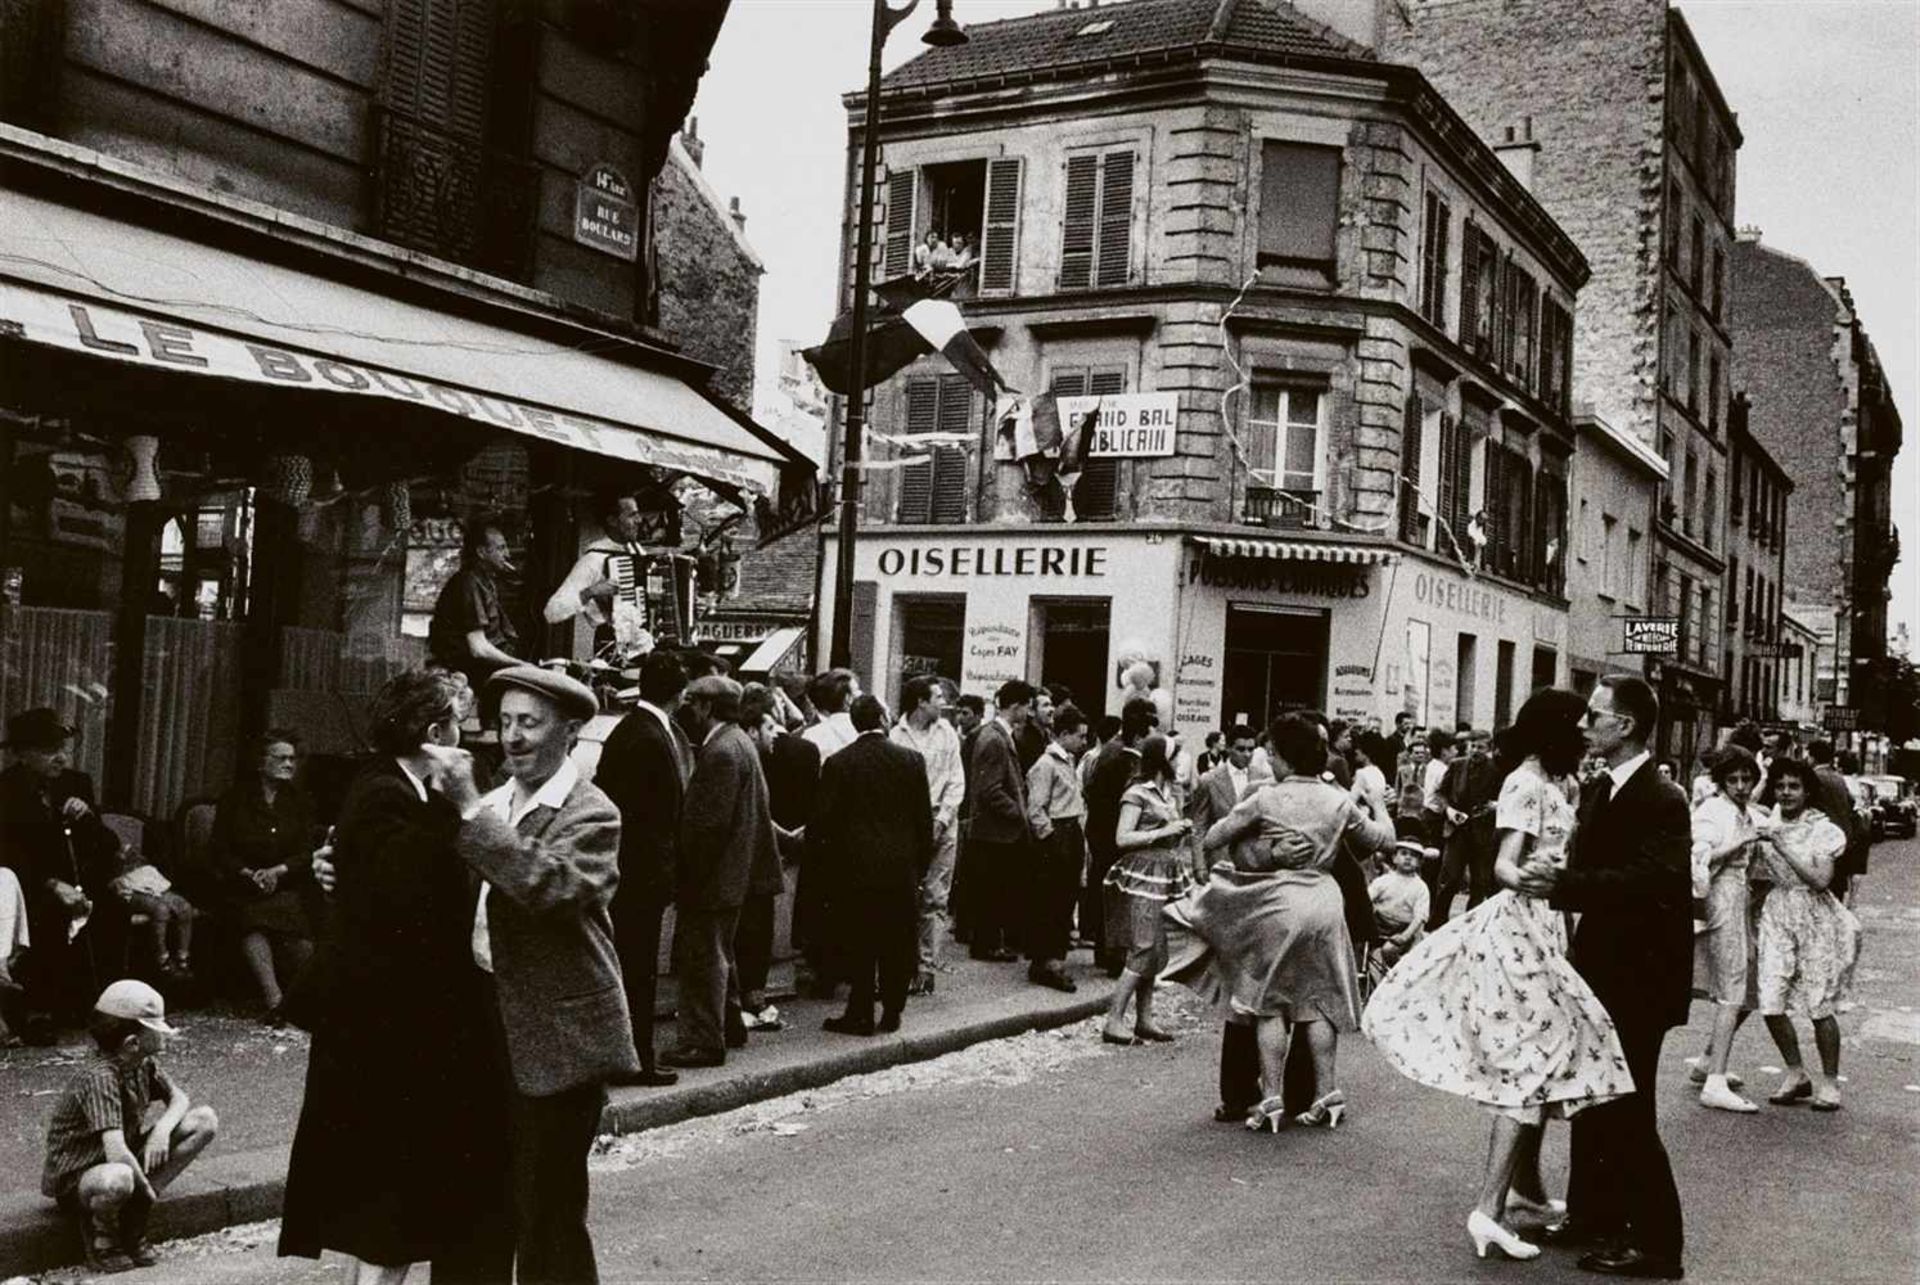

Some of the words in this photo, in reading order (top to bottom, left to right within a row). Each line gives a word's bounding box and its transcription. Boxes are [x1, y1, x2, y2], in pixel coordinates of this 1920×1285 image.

[597, 205, 620, 224] RUE
[581, 217, 632, 246] BOULARD
[68, 304, 209, 369] LE
[244, 343, 602, 449] BOUQUET
[1139, 409, 1173, 426] BAL
[878, 547, 1107, 576] OISELLERIE
[1415, 573, 1505, 622] OISELLERIE
[1626, 622, 1678, 637] LAVERIE
[997, 646, 1018, 657] FAY
[1181, 655, 1214, 668] CAGES
